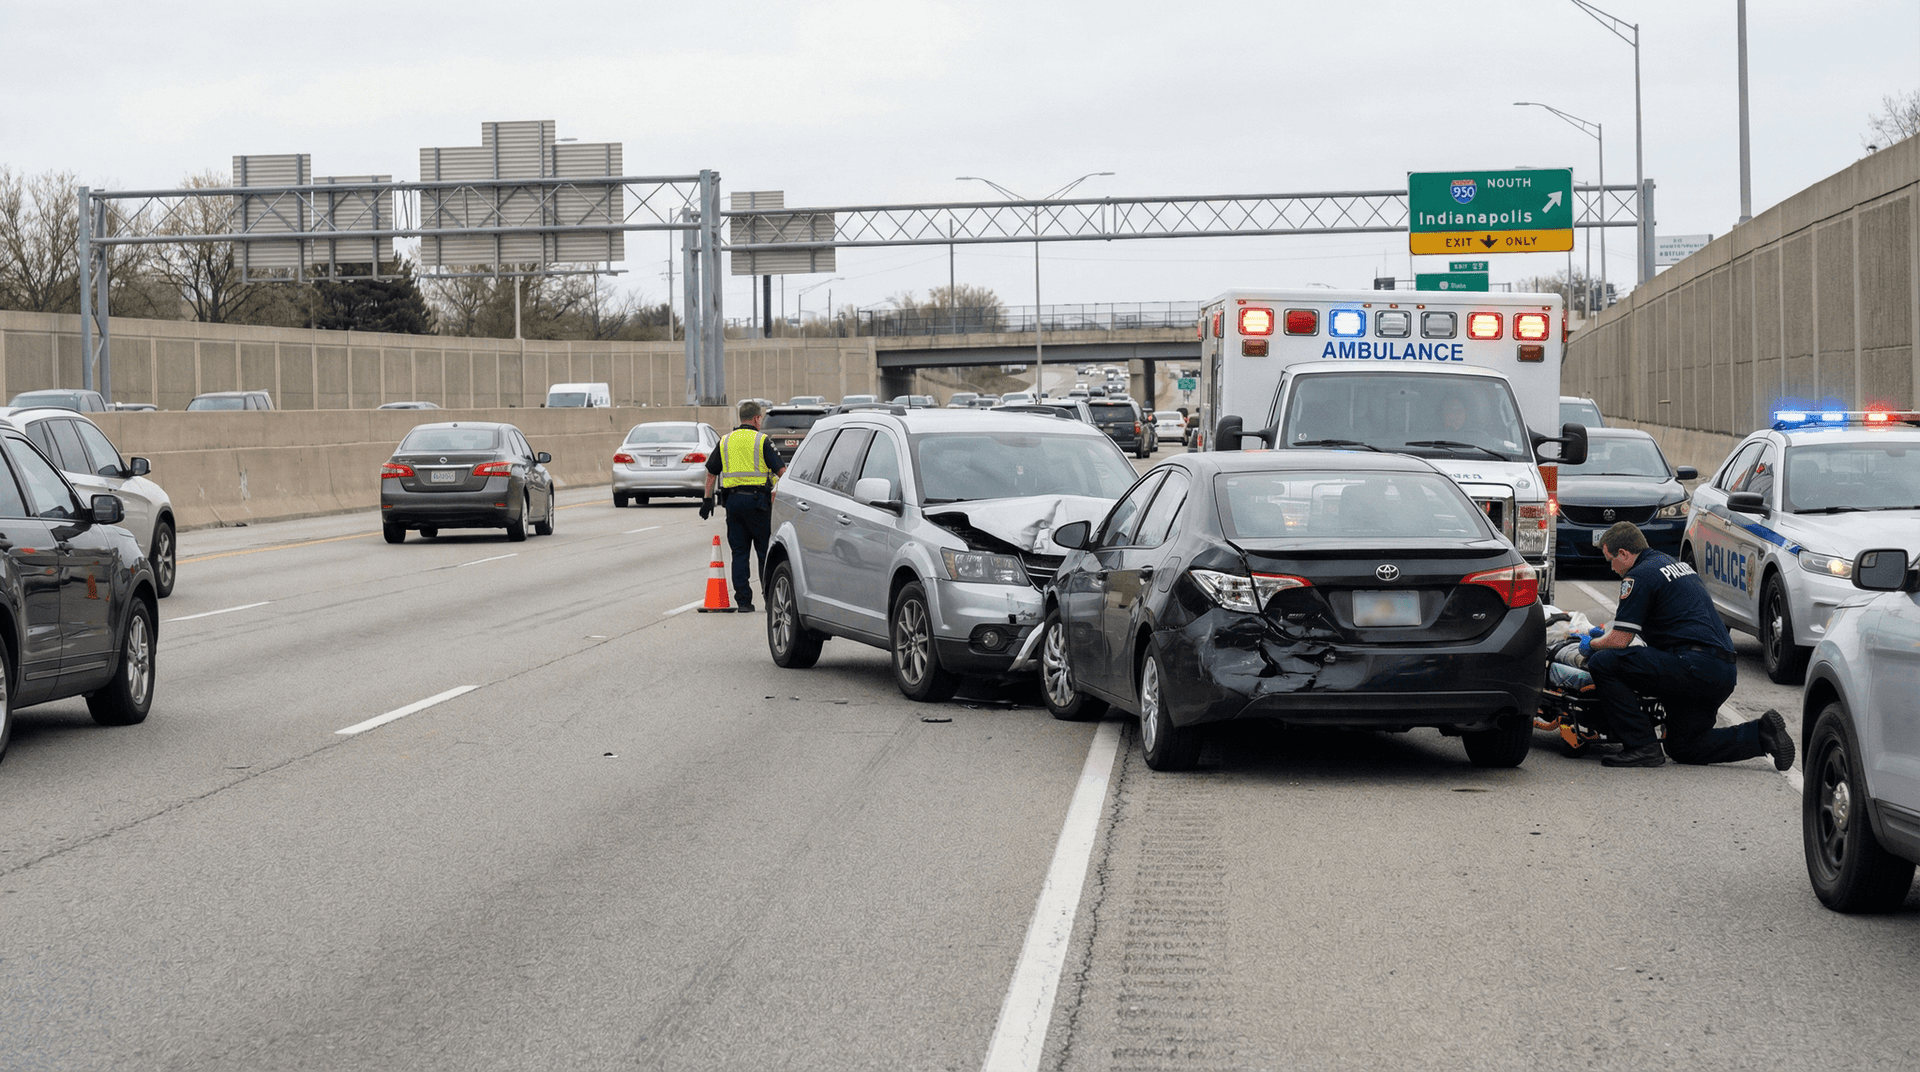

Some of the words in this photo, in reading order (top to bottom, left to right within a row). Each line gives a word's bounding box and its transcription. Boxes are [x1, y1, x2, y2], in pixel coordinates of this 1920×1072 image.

[1487, 178, 1532, 188] NOUTH
[1453, 186, 1475, 198] 950
[1419, 209, 1532, 227] Indianapolis
[1445, 237, 1473, 247] EXIT
[1506, 236, 1538, 246] ONLY
[1322, 341, 1464, 361] AMBULANCE
[1705, 541, 1747, 592] POLICE
